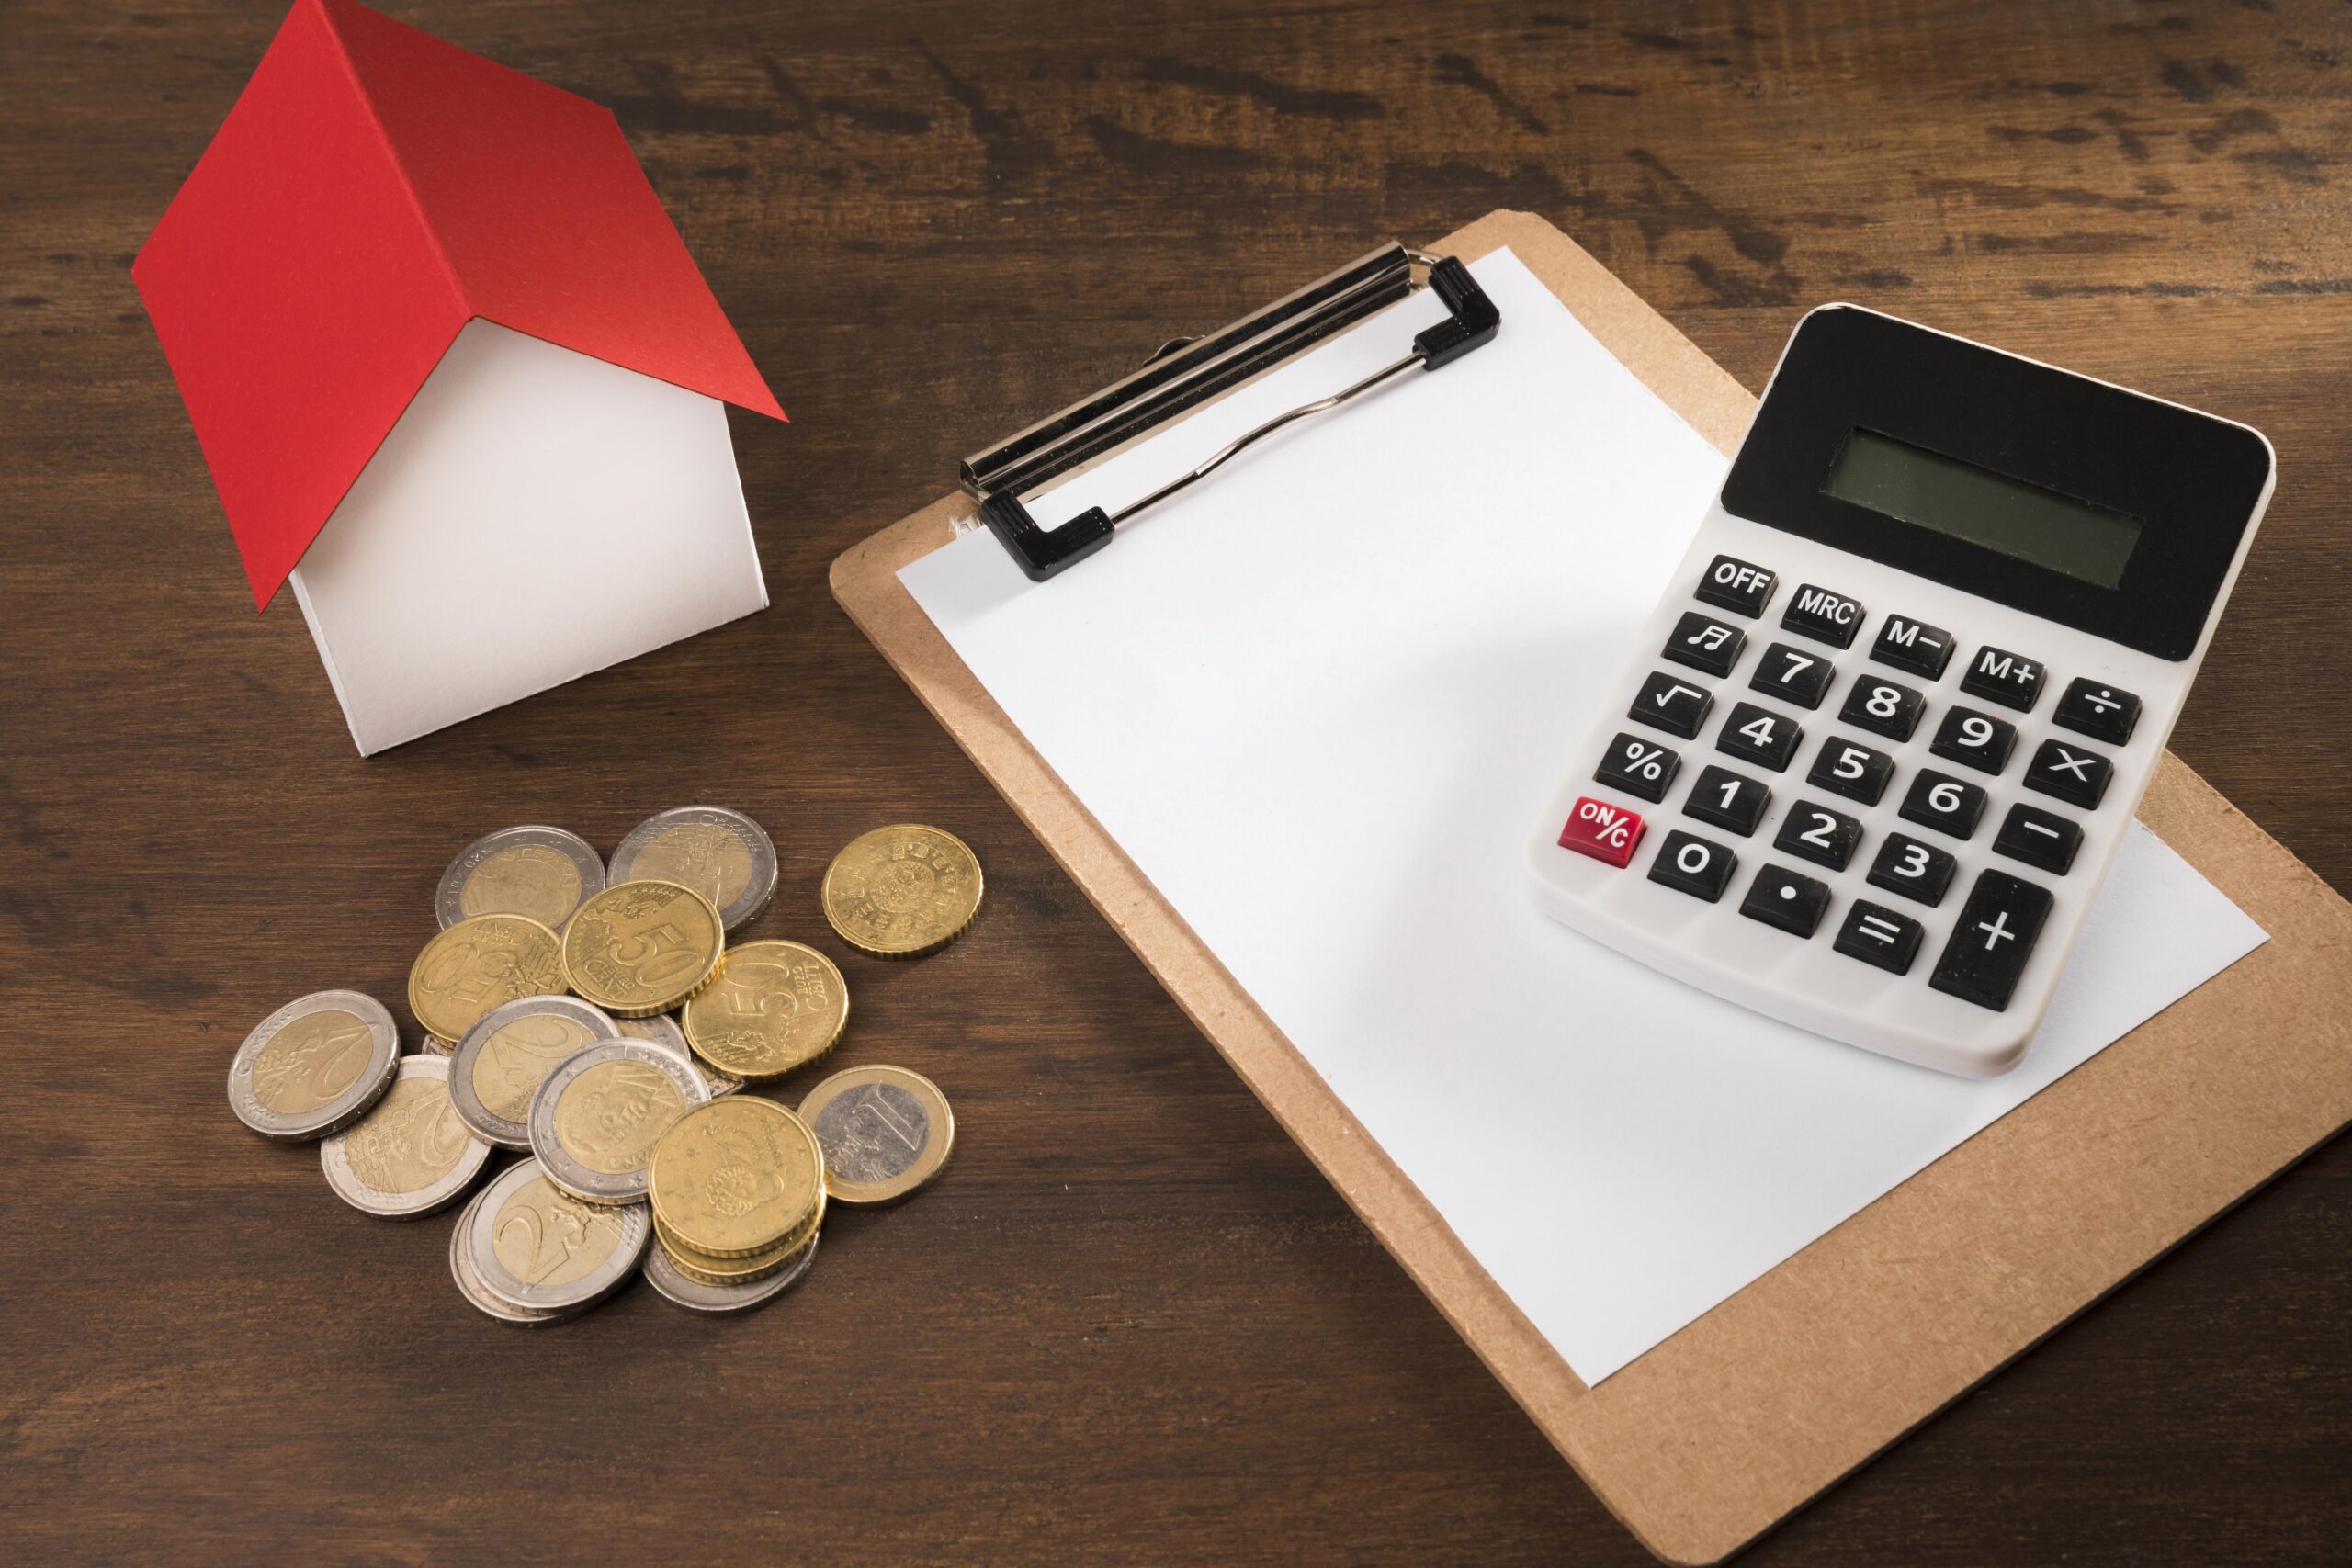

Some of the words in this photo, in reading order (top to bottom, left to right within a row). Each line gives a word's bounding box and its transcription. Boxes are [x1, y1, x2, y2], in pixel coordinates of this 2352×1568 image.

[1715, 562, 1771, 594] OFF
[1798, 590, 1856, 625] MRC
[1887, 621, 1942, 649] M-
[1781, 652, 1815, 683] 7
[1979, 651, 2035, 684] M+
[1866, 687, 1901, 716] 8
[1740, 717, 1775, 746] 4
[1958, 718, 1993, 746] 9
[1624, 742, 1663, 780] %
[1833, 748, 1867, 779] 5
[1721, 781, 1741, 808] 1
[1929, 784, 1962, 812] 6
[1579, 802, 1627, 849] ON/C
[1801, 813, 1836, 848] 2
[1678, 844, 1710, 873] 0
[1894, 845, 1929, 877] 3
[608, 923, 706, 988] 50
[719, 961, 798, 1019] 50
[854, 1079, 927, 1152] 1
[494, 1203, 571, 1295] 2
